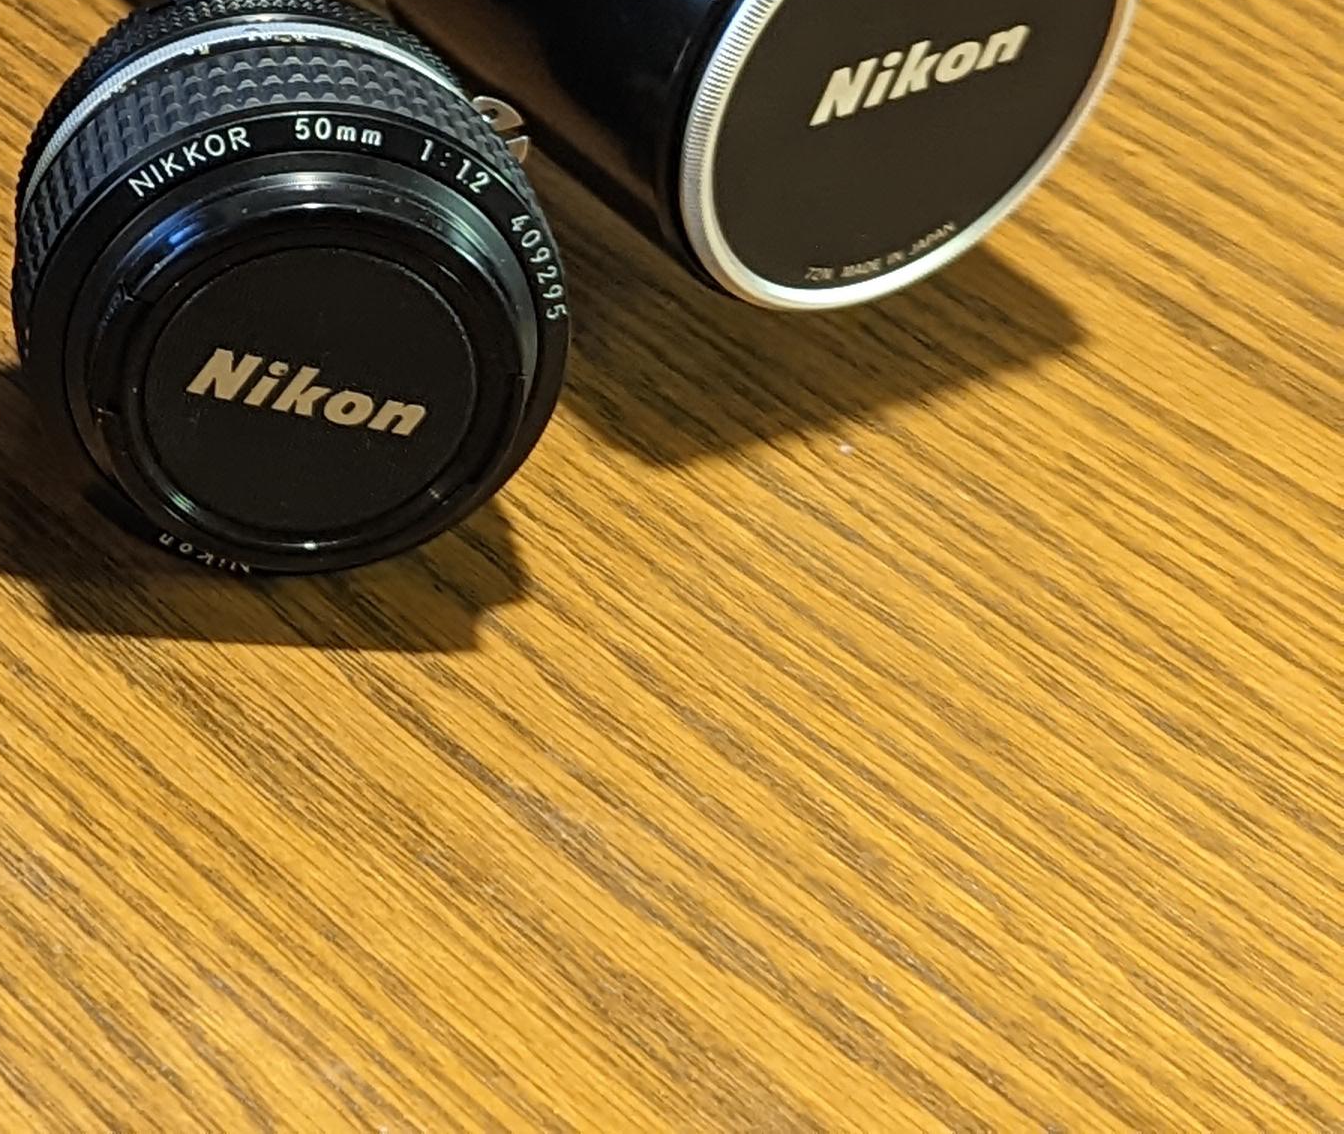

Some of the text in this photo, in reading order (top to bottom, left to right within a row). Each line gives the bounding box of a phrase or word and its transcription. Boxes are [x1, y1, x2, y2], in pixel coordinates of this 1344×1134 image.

[809, 24, 1031, 126] Nikon
[128, 117, 568, 322] NIKKOR 50mm 1:1.2 409295
[186, 348, 428, 437] Nikon
